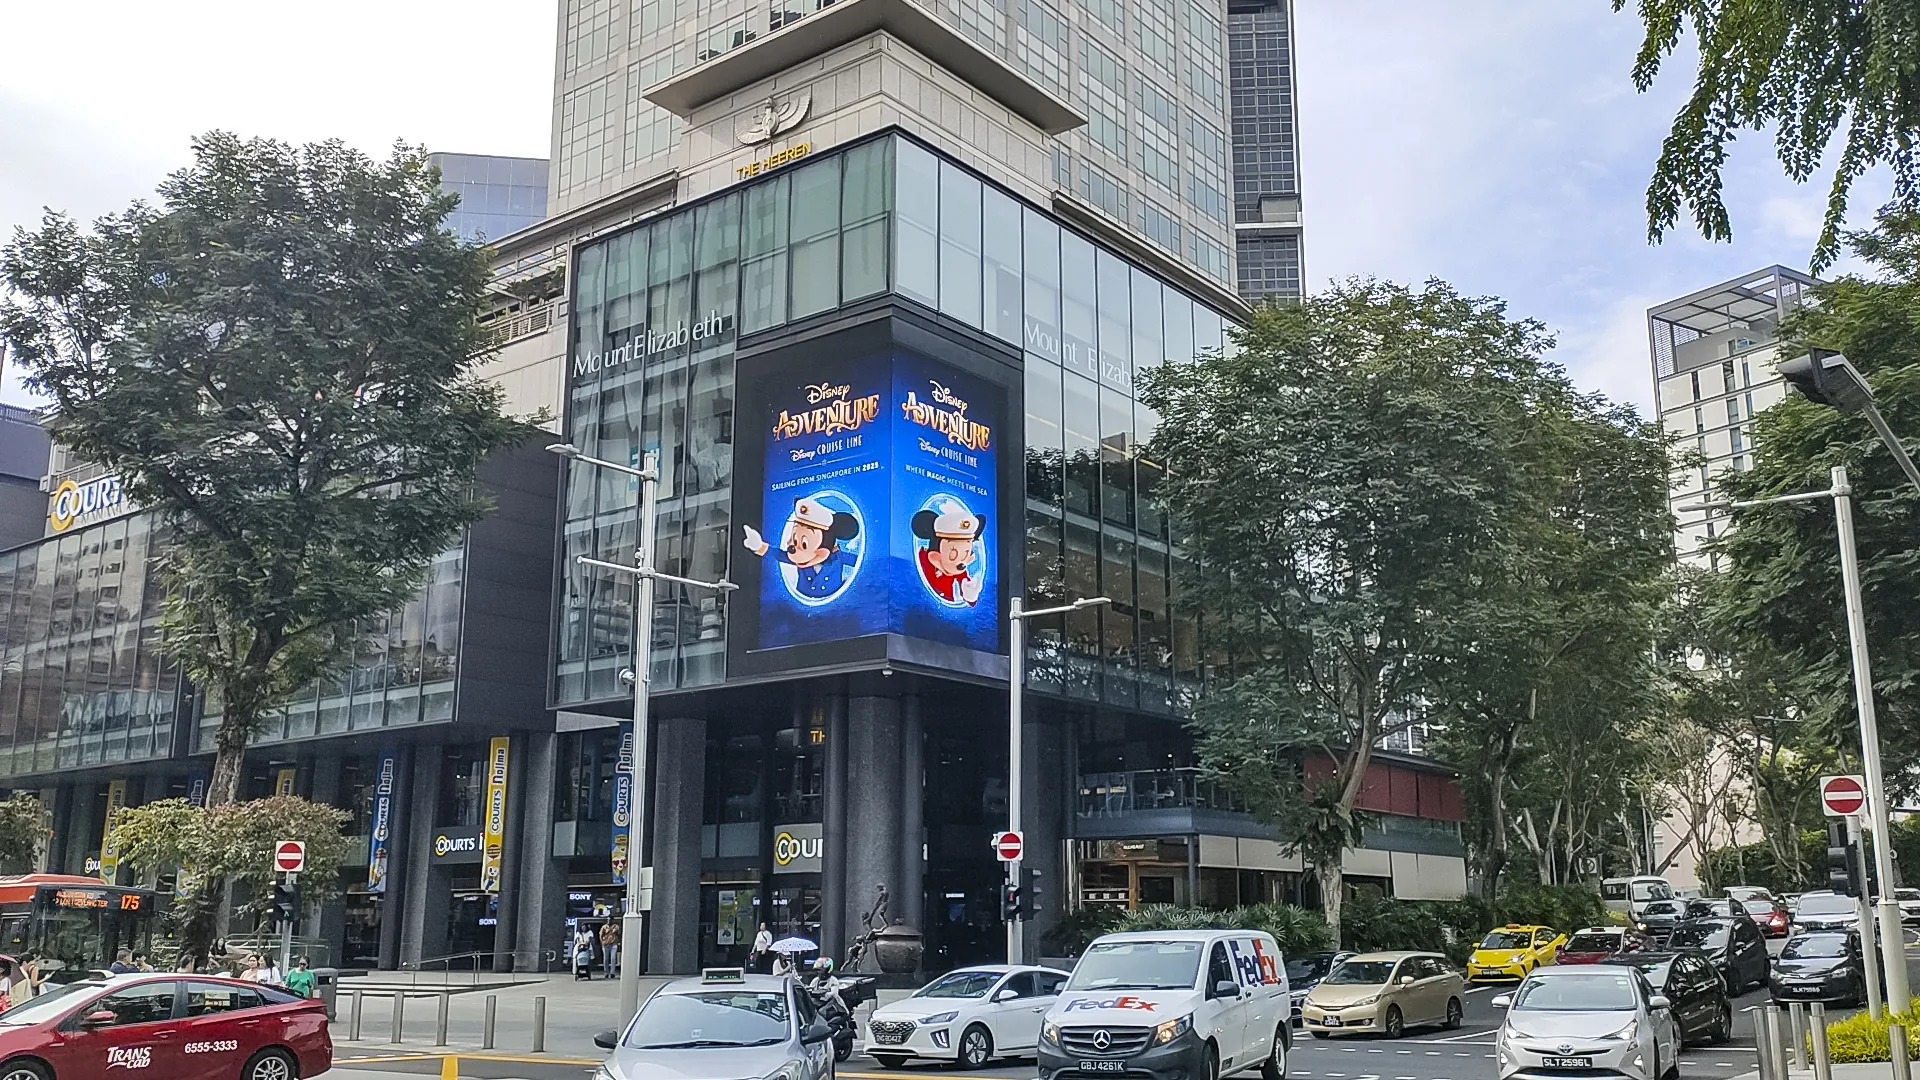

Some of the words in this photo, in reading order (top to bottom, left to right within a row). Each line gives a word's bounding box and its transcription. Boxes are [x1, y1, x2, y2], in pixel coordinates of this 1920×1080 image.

[736, 161, 760, 180] THE
[762, 143, 812, 171] HEEREN
[573, 341, 632, 378] Mount
[634, 310, 723, 360] Elizabeth
[1025, 317, 1078, 364] Mount
[1087, 347, 1131, 388] Elizab
[804, 382, 851, 404] Disney
[929, 380, 968, 415] Disney
[772, 394, 879, 441] ADVENTURE
[902, 391, 990, 451] ADVENTURE
[790, 448, 816, 462] Disney
[817, 440, 843, 455] CRUISE
[846, 435, 863, 449] LINE
[941, 446, 963, 462] CRUISE
[964, 454, 978, 468] LINE
[771, 480, 796, 491] SAILING
[797, 475, 815, 486] FROM
[816, 467, 852, 482] SINGAPORE
[853, 466, 861, 474] IN
[905, 464, 925, 476] WHERE
[926, 470, 946, 483] MAGIC
[947, 477, 965, 490] MEETS
[965, 484, 977, 493] THE
[977, 487, 988, 496] SEA
[51, 476, 124, 531] COURT
[489, 789, 504, 835] COURTS
[614, 776, 629, 827] COURTS
[375, 797, 389, 841] COURTS
[435, 835, 475, 856] COURTS
[775, 832, 823, 866] COU
[121, 895, 141, 910] 175
[1228, 938, 1282, 987] FedEx
[1064, 997, 1160, 1012] FedEx
[106, 1046, 152, 1063] TRANS
[184, 1040, 238, 1054] 6555-3333
[1543, 1058, 1591, 1067] SLT2596L
[126, 1058, 150, 1069] cab
[1080, 1061, 1124, 1071] GBJ4261K
